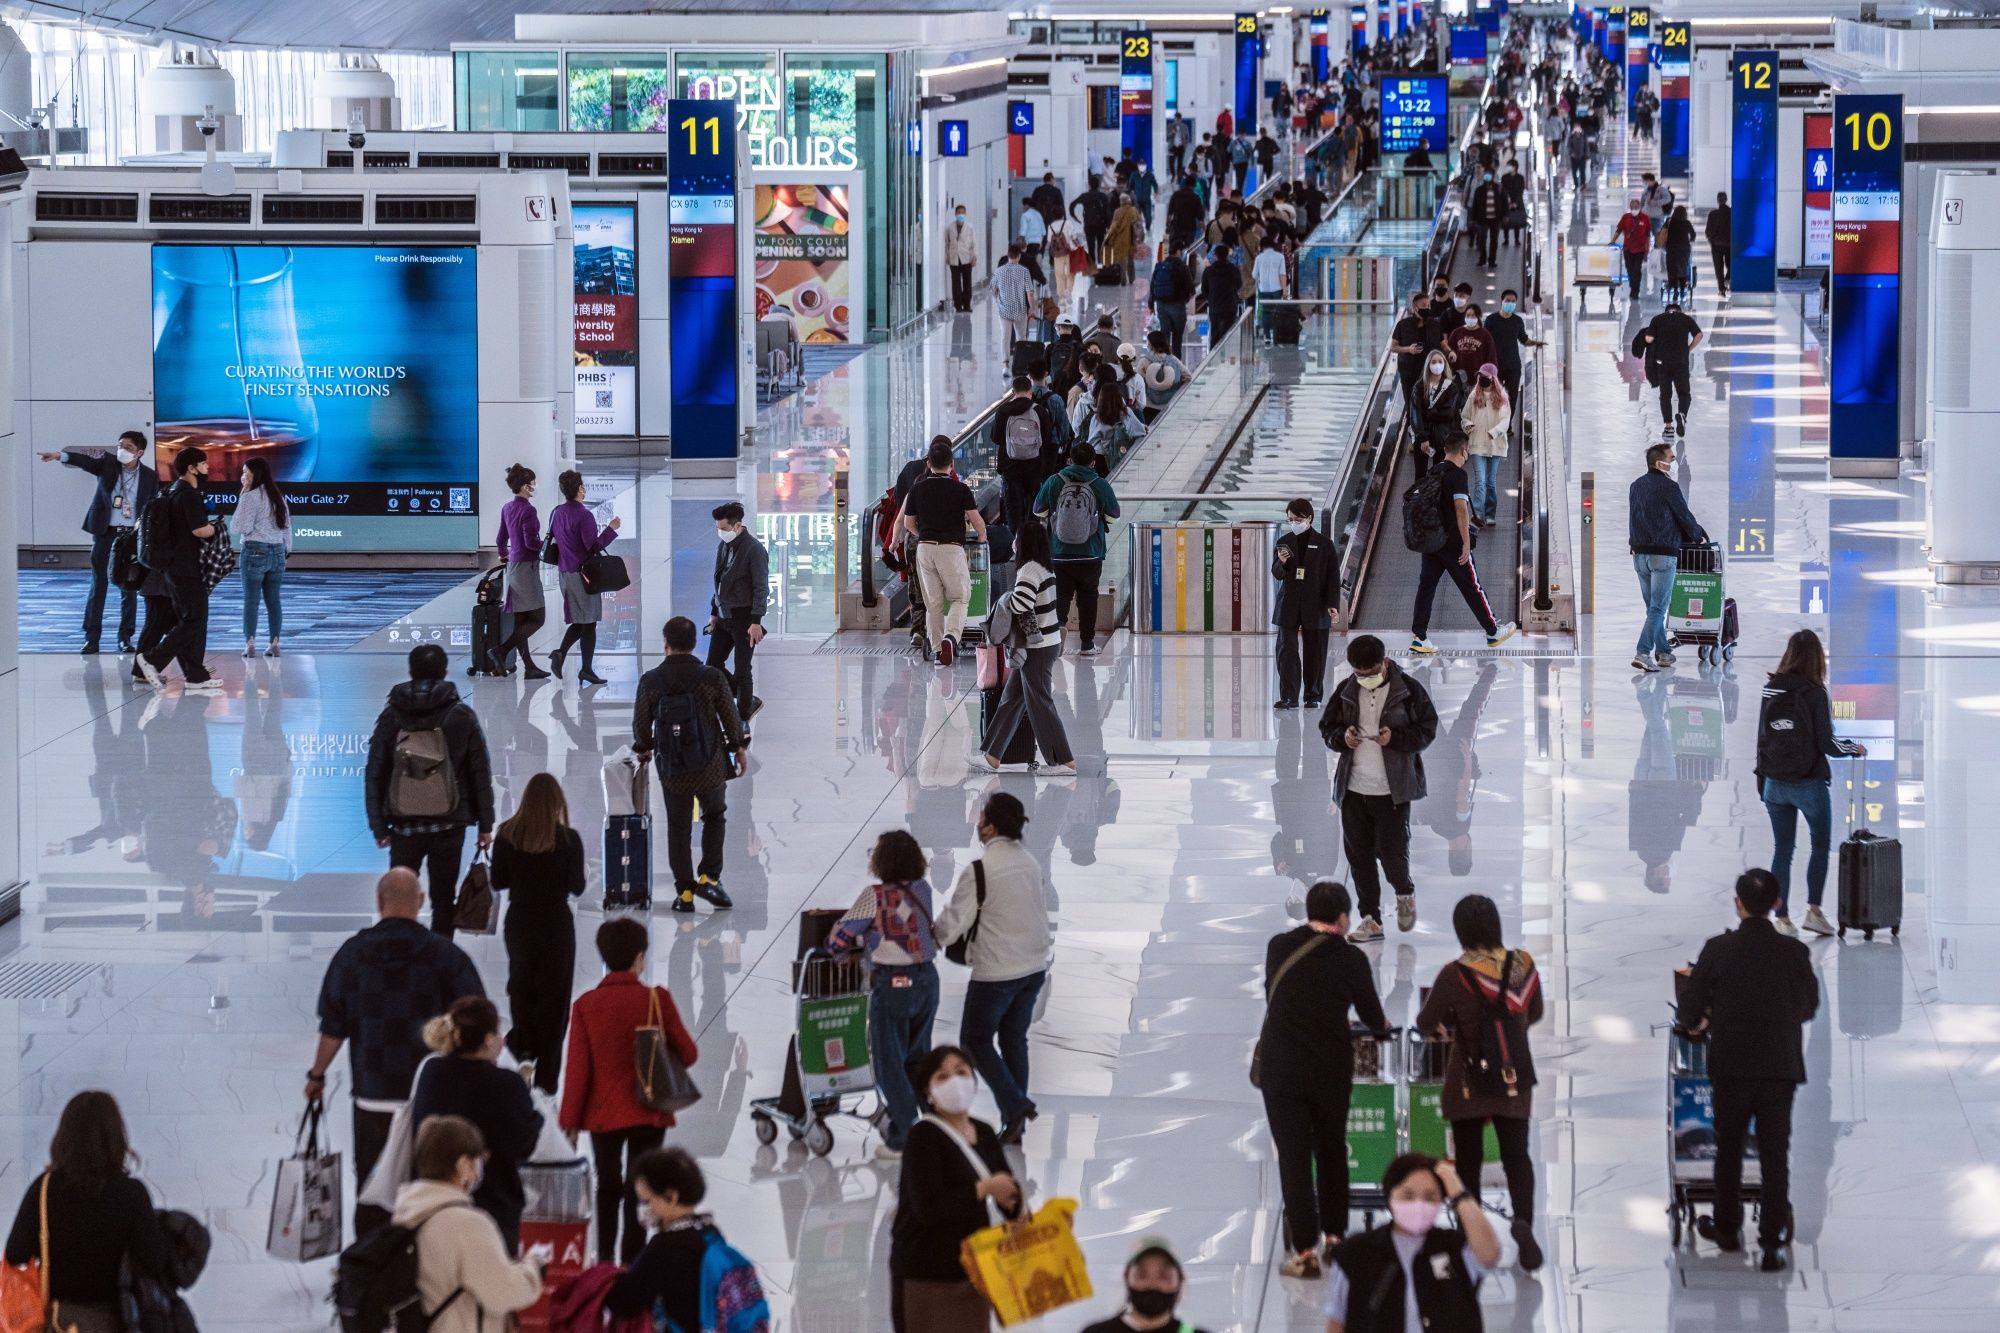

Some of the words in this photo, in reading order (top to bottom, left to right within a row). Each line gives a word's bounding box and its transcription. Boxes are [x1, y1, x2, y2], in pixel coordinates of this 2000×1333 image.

[1237, 17, 1256, 32] 25
[1630, 11, 1648, 26] 26
[1664, 28, 1687, 46] 24
[1125, 38, 1149, 57] 23
[1739, 62, 1771, 89] 12
[695, 76, 780, 110] OPEN
[1399, 99, 1431, 112] 13-22
[681, 117, 719, 155] 11
[1844, 112, 1892, 151] 10
[748, 136, 858, 170] HOURS
[671, 200, 683, 208] CX
[684, 200, 699, 208] 978
[713, 200, 734, 208] 17:50
[1835, 197, 1849, 205] HO
[1851, 197, 1869, 205] 1302
[1878, 197, 1899, 205] 17:15
[671, 236, 695, 244] Xiamen
[772, 238, 802, 246] FOOD
[807, 238, 845, 246] COURT
[1835, 233, 1859, 242] Nanjing
[807, 246, 847, 257] SOON
[375, 254, 399, 263] Please
[400, 254, 419, 263] Drink
[420, 254, 463, 264] Responsibly
[580, 332, 615, 342] School
[225, 365, 306, 379] CURATING
[308, 366, 335, 379] THE
[339, 365, 406, 379] WORLD'S
[577, 373, 607, 382] PHBS
[246, 384, 294, 397] FINEST
[298, 384, 390, 397] SENSATIONS
[415, 488, 434, 496] Follow
[285, 494, 310, 504] Near
[311, 494, 335, 504] Gate
[337, 494, 350, 504] 27
[294, 528, 342, 537] JCDecaux
